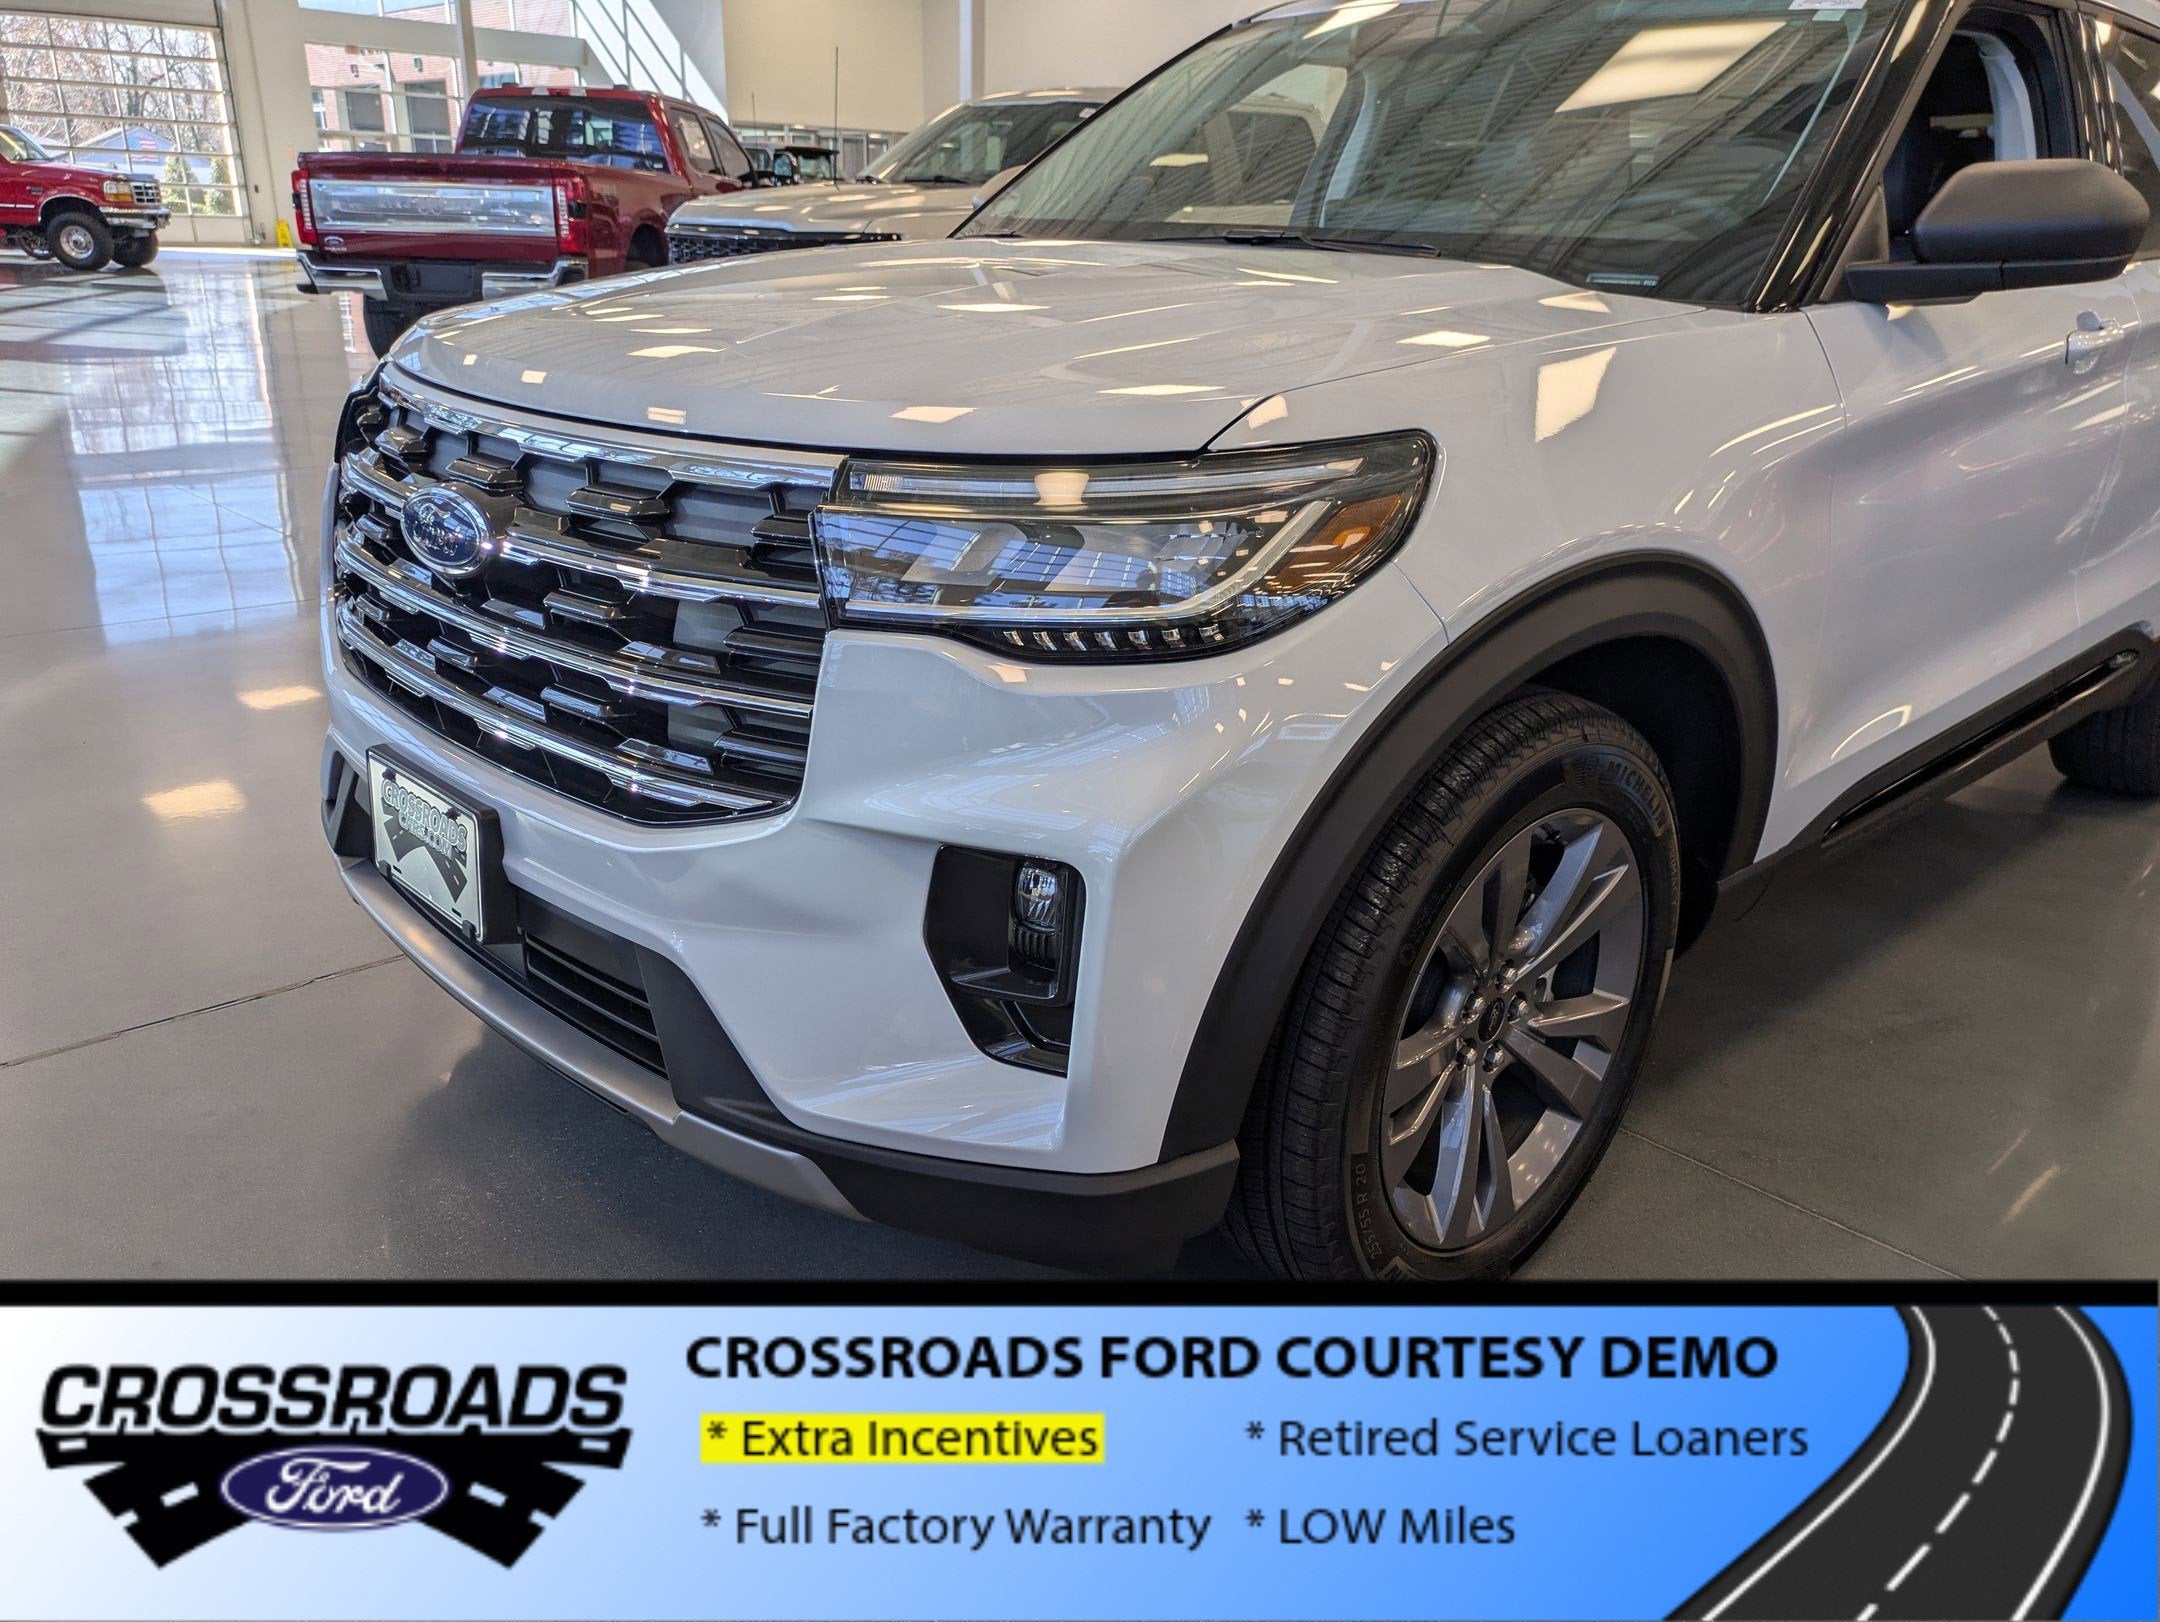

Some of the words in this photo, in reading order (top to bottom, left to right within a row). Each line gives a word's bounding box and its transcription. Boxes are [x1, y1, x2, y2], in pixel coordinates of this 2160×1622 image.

[382, 778, 468, 853] CROSSROADS
[1607, 760, 1666, 829] MICHELIN
[1355, 1163, 1368, 1186] 20
[1356, 1192, 1369, 1209] R
